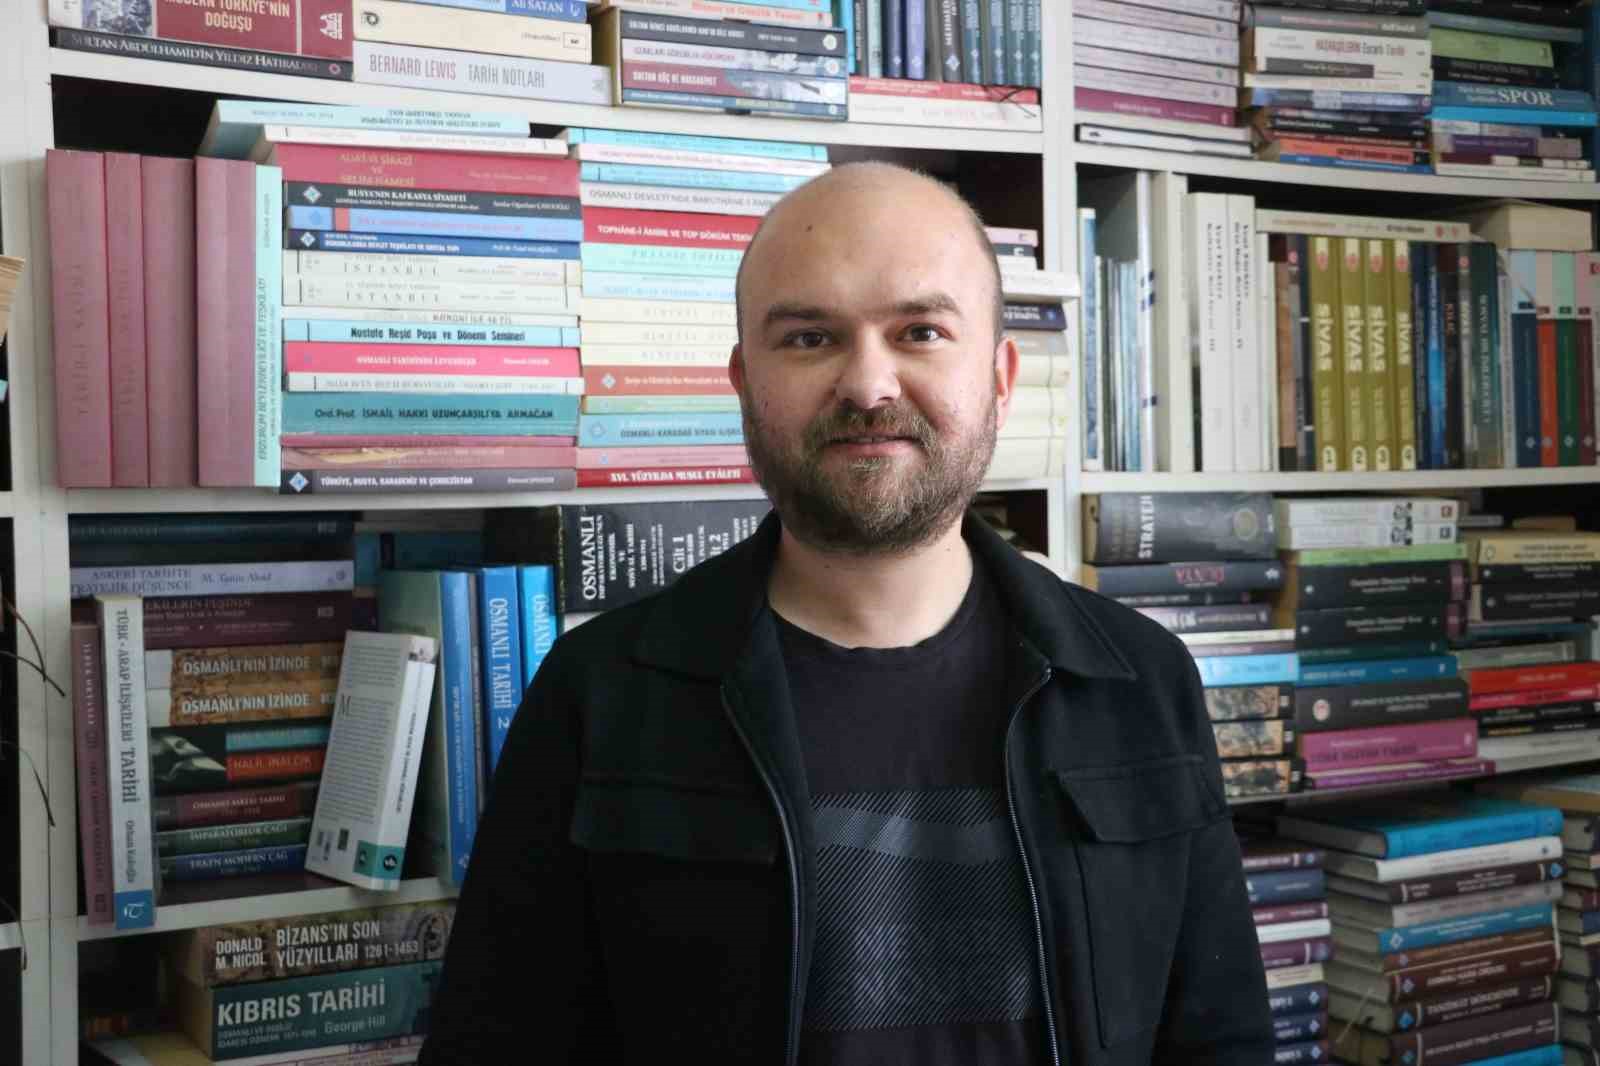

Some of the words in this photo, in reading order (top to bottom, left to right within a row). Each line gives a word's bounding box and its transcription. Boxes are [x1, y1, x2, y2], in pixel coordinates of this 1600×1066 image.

[205, 12, 253, 32] DOĞUŞU
[369, 54, 421, 77] BERNARD
[424, 60, 457, 81] LEWIS
[468, 64, 499, 84] TARİH
[502, 67, 545, 89] NOTLARI
[589, 189, 631, 200] OSMANLI
[682, 230, 698, 239] TOP
[362, 406, 393, 418] İSMAİL
[398, 407, 428, 418] HAKKI
[506, 407, 553, 418] ARMAĞAN
[610, 472, 630, 483] XVI.
[632, 471, 674, 483] YÜZYILDA
[675, 470, 704, 481] MUSUL
[710, 533, 721, 543] 2
[580, 516, 597, 600] OSMANLI
[672, 547, 686, 574] Cilt
[116, 609, 128, 640] TÜRK
[489, 598, 508, 658] OSMANLI
[533, 593, 551, 654] OSMANLI
[117, 649, 130, 680] ARAP
[183, 656, 267, 676] OSMANLI'NIN
[269, 654, 310, 672] İZİNDE
[492, 663, 513, 708] TARİHİ
[117, 683, 132, 741] İLİŞKİLERİ
[181, 695, 266, 715] OSMANLI'NIN
[268, 692, 310, 713] İZİNDE
[498, 716, 510, 730] 2
[120, 747, 141, 803] TARİHİ
[223, 855, 266, 866] MODERN
[276, 922, 349, 946] BİZANS'IN
[352, 920, 380, 939] SON
[215, 955, 229, 970] M.
[233, 952, 266, 968] NICOL
[216, 937, 262, 955] DONALD
[276, 943, 358, 968] YÜZYILLARI
[217, 993, 301, 1027] KIBRIS
[307, 978, 386, 1015] TARİHİ
[324, 1018, 365, 1034] George
[368, 1015, 386, 1029] Hill
